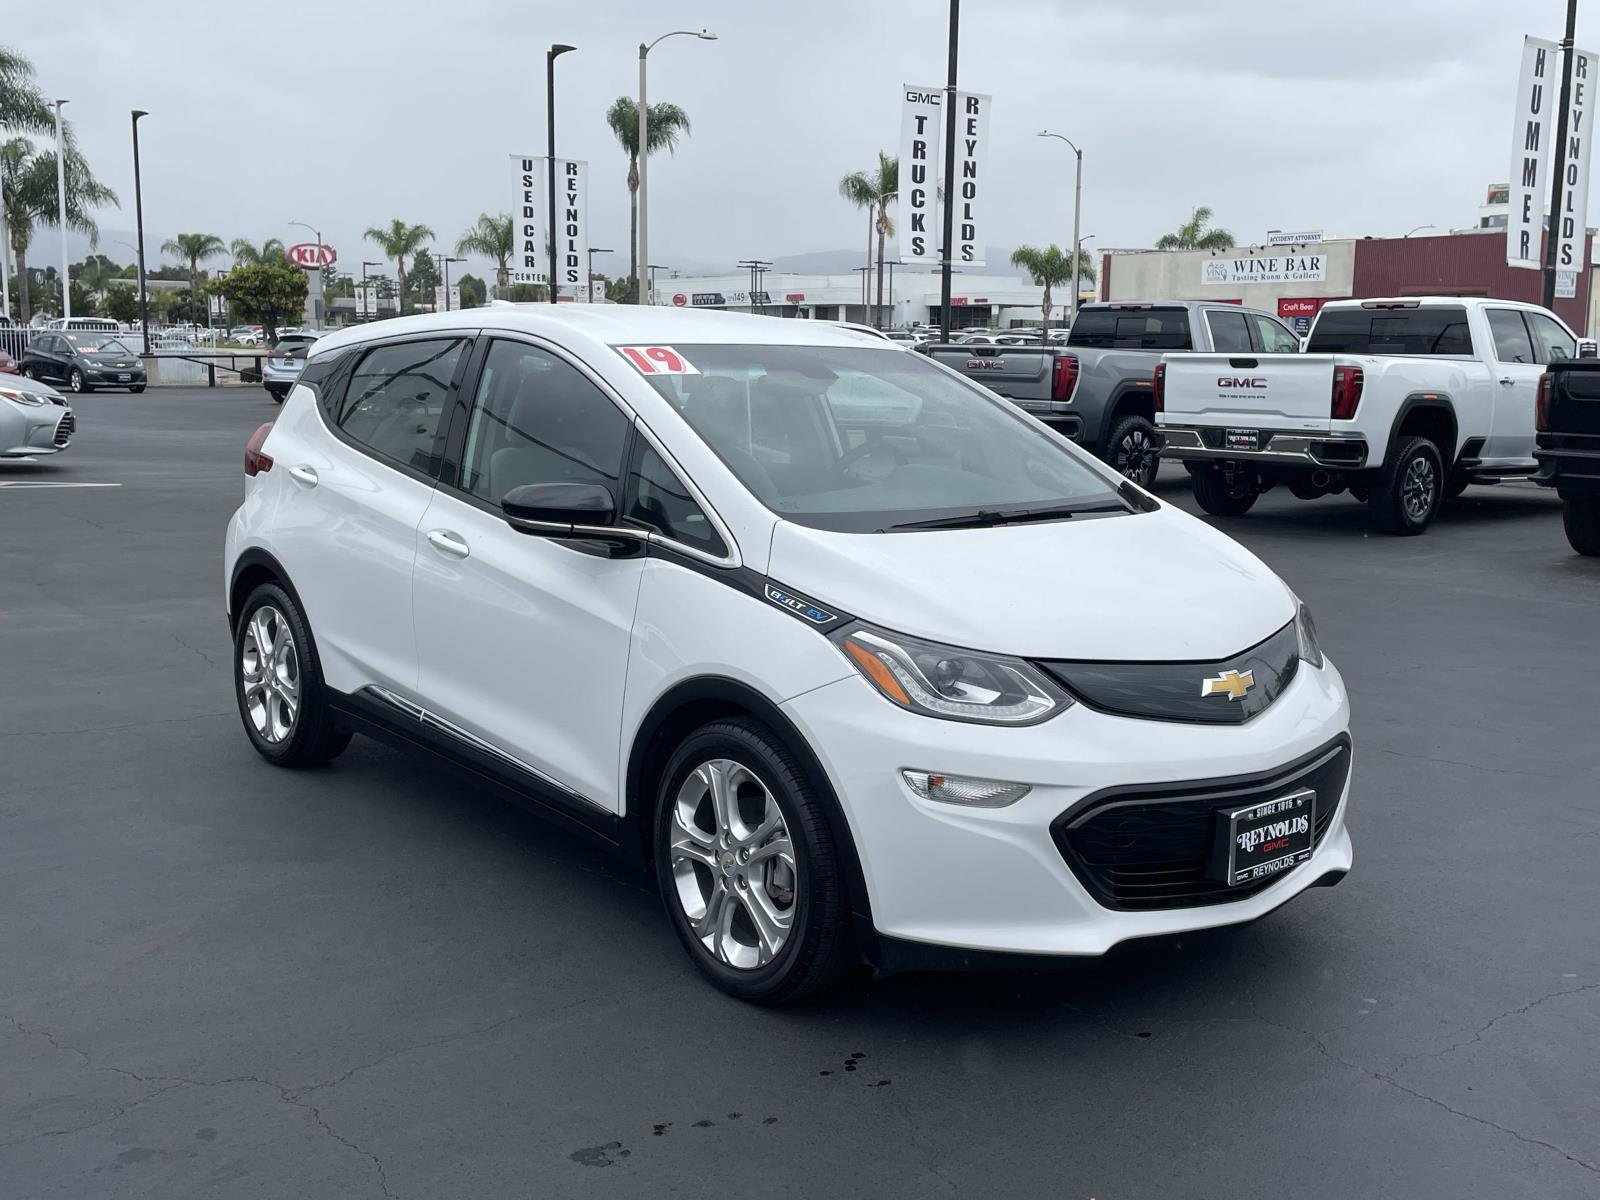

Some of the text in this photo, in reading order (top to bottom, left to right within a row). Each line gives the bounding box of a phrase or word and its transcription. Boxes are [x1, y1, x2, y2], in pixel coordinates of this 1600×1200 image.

[906, 91, 940, 106] GMC
[1520, 48, 1546, 260] HUMMER
[1561, 55, 1588, 265] REYNOLDS
[911, 115, 928, 256] TRUCKS
[961, 96, 980, 262] REYNOLDS
[522, 159, 535, 268] USED CAR
[566, 162, 578, 283] REYNOLDS
[1294, 233, 1321, 241] ATTORNEY
[298, 248, 325, 264] KIA
[1234, 256, 1320, 273] WINE BAR
[514, 272, 548, 283] CENTER
[1284, 272, 1290, 280] &
[1293, 271, 1321, 280] Gallery
[1283, 303, 1314, 311] Craft Beer
[623, 348, 684, 373] 19
[967, 360, 1004, 370] GMC
[1218, 378, 1267, 389] GMC
[770, 590, 828, 620] BOLT EV
[1256, 800, 1293, 818] SINCE 1915
[1237, 814, 1309, 852] REYNOLDS
[1263, 838, 1289, 853] GMC
[1253, 856, 1295, 878] REYNOLDS
